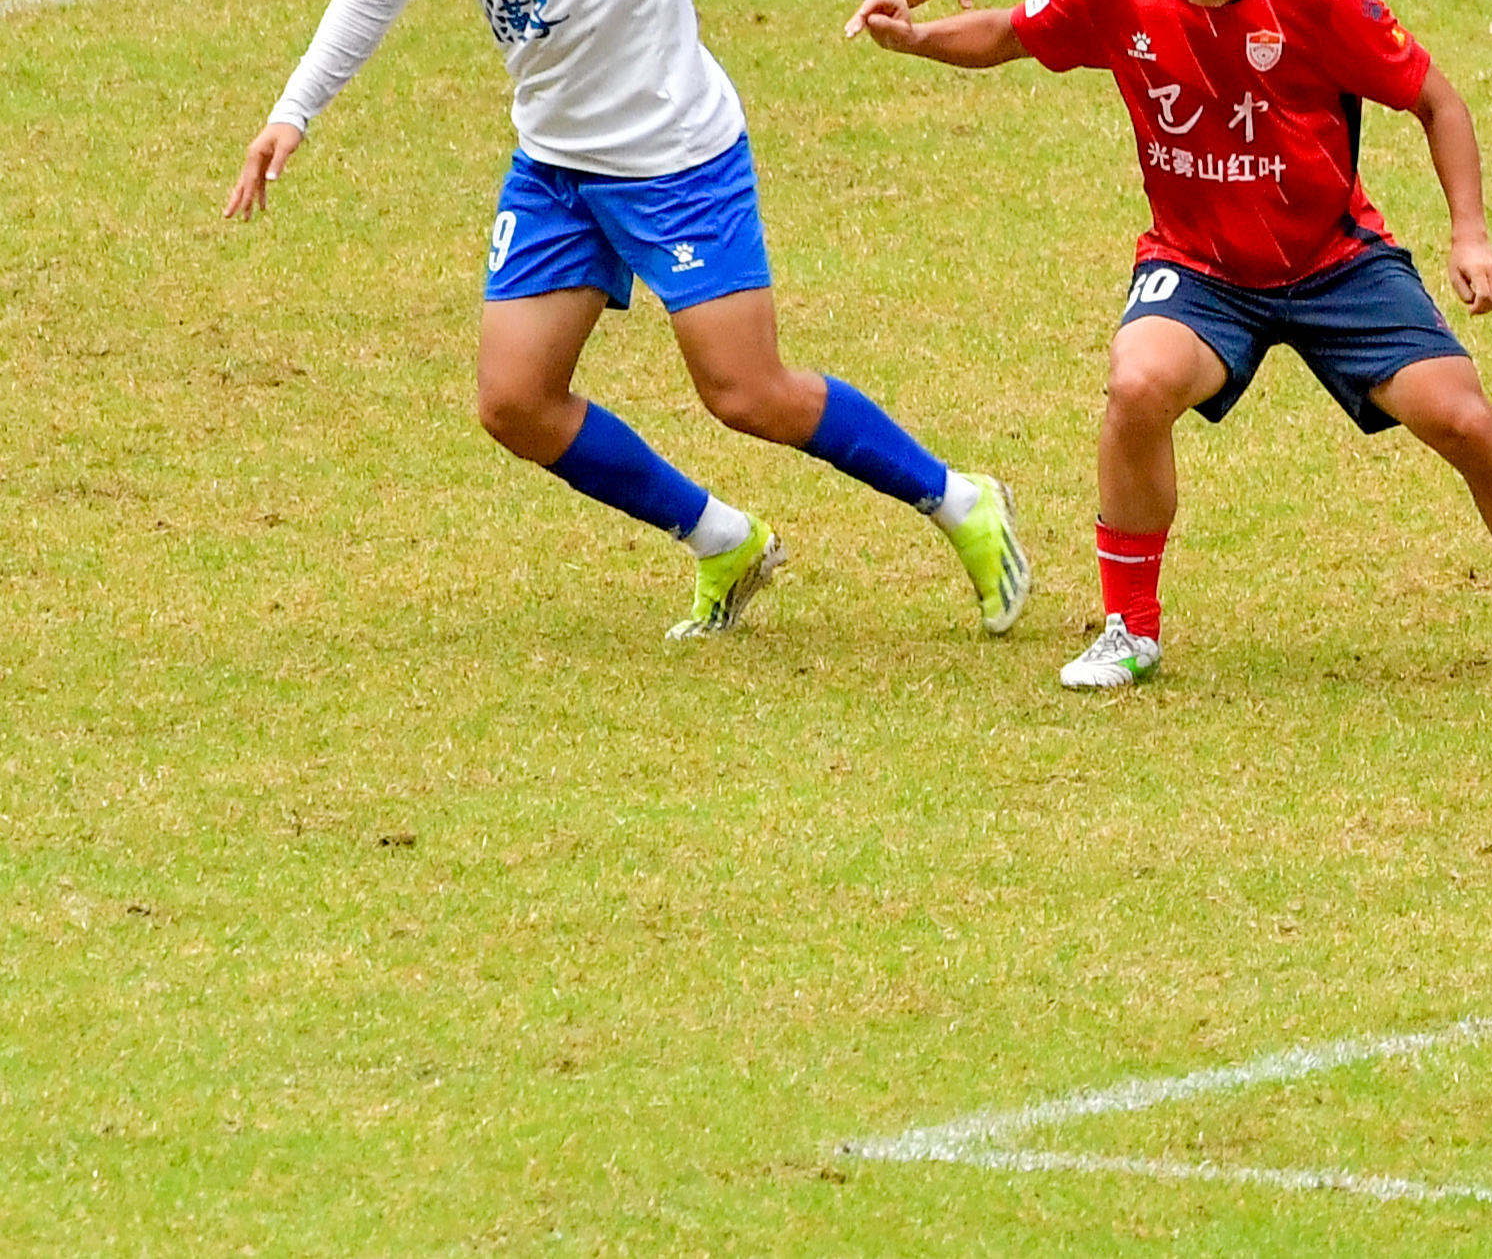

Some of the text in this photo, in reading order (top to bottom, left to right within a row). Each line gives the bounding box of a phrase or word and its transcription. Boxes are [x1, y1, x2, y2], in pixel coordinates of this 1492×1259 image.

[1147, 141, 1287, 183] 光雾山红叶
